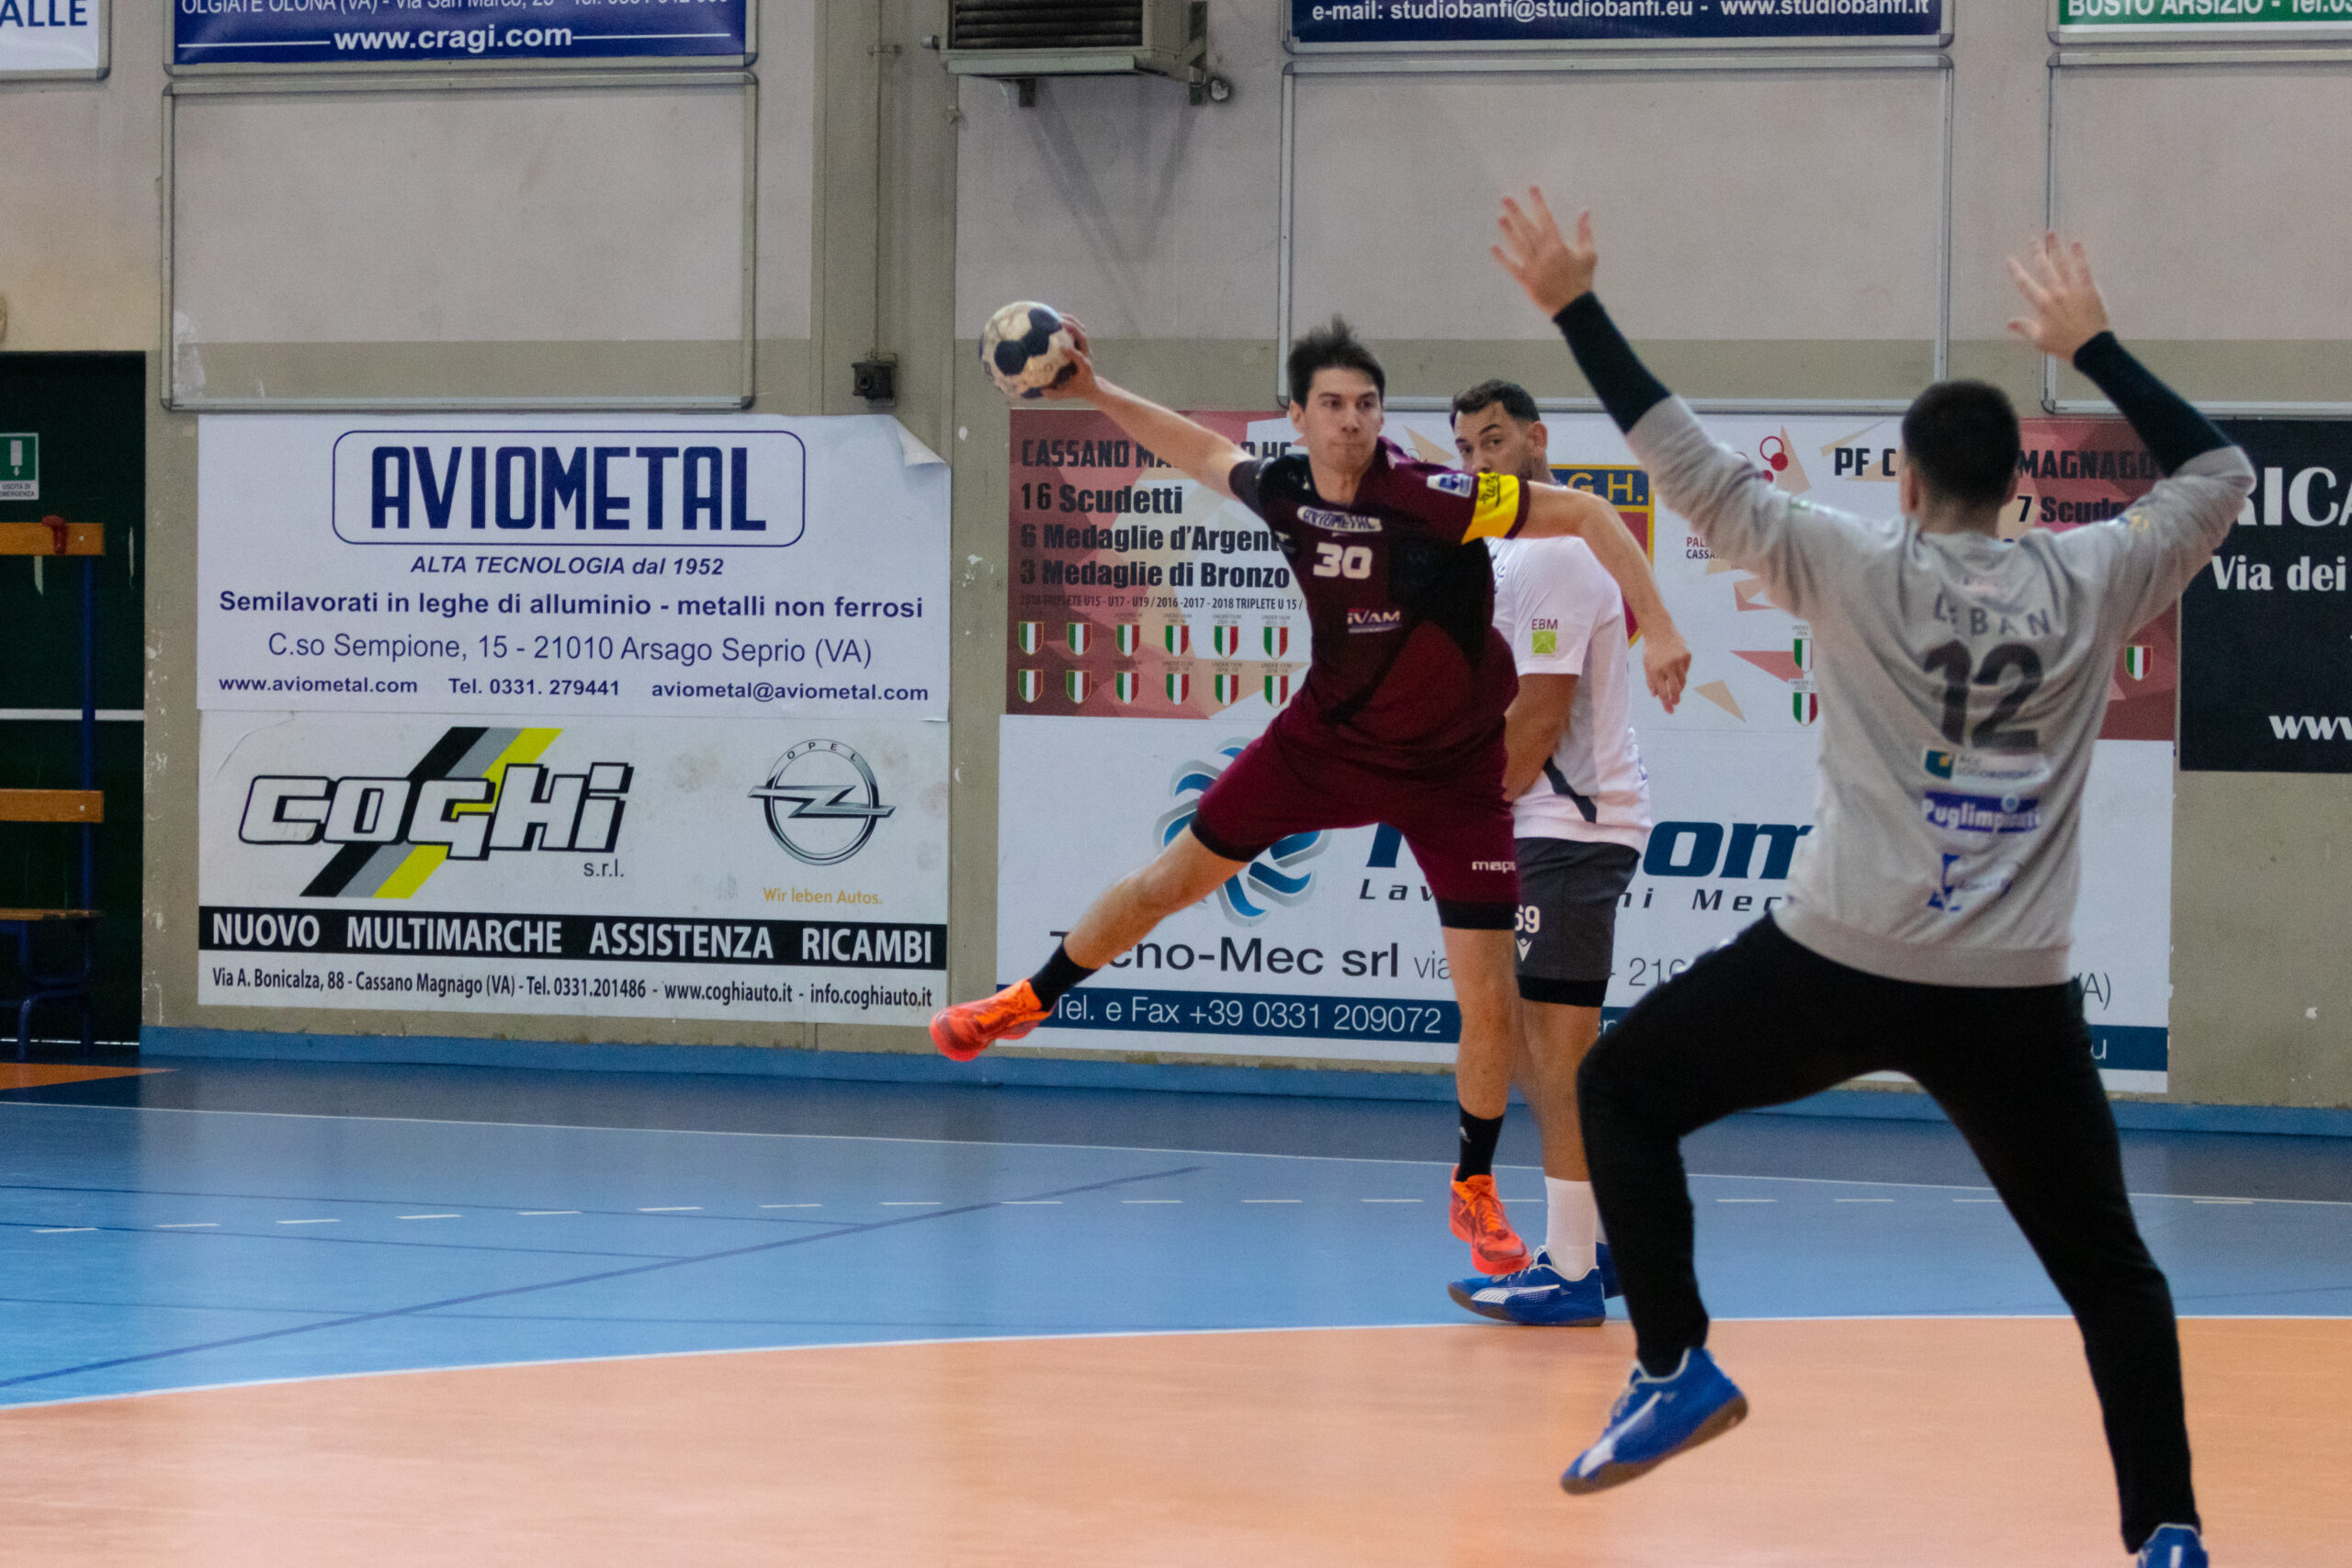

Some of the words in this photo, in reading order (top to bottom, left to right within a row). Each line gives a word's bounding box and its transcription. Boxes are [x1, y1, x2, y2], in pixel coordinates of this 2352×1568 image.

[1312, 2, 1382, 20] e-mail:
[1390, 0, 1692, 22] studiobanfi@studiobanfi.eu
[1721, 0, 1928, 15] www.studiobanfi.it
[2068, 0, 2154, 17] BUSTO
[2160, 0, 2263, 15] ARSIZIO
[334, 24, 572, 53] www.cragi.com
[1021, 439, 1130, 468] CASSANO
[1835, 447, 1871, 477] PF
[372, 446, 766, 531] AVIOMETAL
[1021, 483, 1051, 511] 16
[1059, 485, 1182, 514] Scudetti
[2236, 467, 2352, 527] IC
[2017, 495, 2032, 523] 7
[1021, 525, 1036, 549] 6
[1043, 525, 1164, 553] Medaglie
[1170, 525, 1281, 552] d'Argent
[411, 557, 466, 572] ALTA
[476, 557, 624, 574] TECNOLOGIA
[632, 558, 665, 574] dal
[674, 558, 723, 575] 1952
[1021, 559, 1036, 585] 3
[1043, 560, 1163, 589] Medaglie
[1169, 561, 1193, 587] di
[1200, 562, 1290, 588] Bronzo
[1313, 542, 1373, 580] 30
[2211, 555, 2274, 591] Via
[2286, 556, 2346, 592] dei
[220, 591, 377, 612] Semilavorati
[389, 592, 409, 612] in
[420, 592, 488, 618] leghe
[498, 593, 520, 613] di
[530, 594, 650, 615] alluminio
[678, 596, 764, 615] metalli
[775, 602, 824, 616] non
[834, 596, 922, 617] ferrosi
[1084, 596, 1101, 607] U15
[1108, 596, 1124, 607] U17
[1132, 596, 1149, 607] U19
[1157, 597, 1179, 608] 2016
[1212, 598, 1234, 609] 2018
[1236, 598, 1275, 610] TRIPLETE
[1278, 599, 1284, 610] U
[1286, 599, 1297, 610] 15
[1532, 619, 1558, 630] EBM
[269, 632, 324, 656] C.so
[334, 633, 466, 662] Sempione,
[480, 636, 507, 658] 15
[535, 636, 613, 660] 21010
[621, 637, 712, 666] Arsago
[722, 637, 805, 667] Seprio
[816, 639, 871, 669] (VA)
[219, 676, 417, 693] www.aviometal.com
[448, 678, 481, 694] Tel.
[490, 679, 541, 694] 0331.
[549, 680, 617, 695] 279441
[652, 682, 928, 702] aviometal@aviometal.com
[1924, 639, 2044, 749] 12
[785, 741, 858, 765] OPEL
[583, 859, 624, 877] s.r.l.
[763, 886, 788, 904] Wir
[791, 886, 832, 906] leben
[837, 889, 883, 906] Autos.
[214, 914, 320, 946] NUOVO
[347, 917, 561, 953] MULTIMARCHE
[589, 923, 774, 958] ASSISTENZA
[803, 928, 931, 963] RICAMBI
[1341, 942, 1398, 978] srl
[212, 967, 233, 987] Via
[237, 969, 251, 987] A.
[254, 969, 323, 992] Bonicalza,
[327, 971, 345, 989] 88
[356, 972, 413, 992] Cassano
[416, 973, 483, 998] Magnago
[486, 975, 515, 998] (VA)
[526, 976, 550, 996] Tel.
[554, 976, 646, 998] 0331.201486
[664, 981, 793, 1007] www.coghiauto.it
[810, 983, 932, 1010] info.coghiauto.it
[1056, 993, 1095, 1021] Tel.
[1105, 1002, 1122, 1021] e
[1131, 996, 1181, 1024] Fax
[1189, 999, 1243, 1027] +39
[1252, 1000, 1321, 1030] 0331
[1333, 1004, 1442, 1034] 209072
